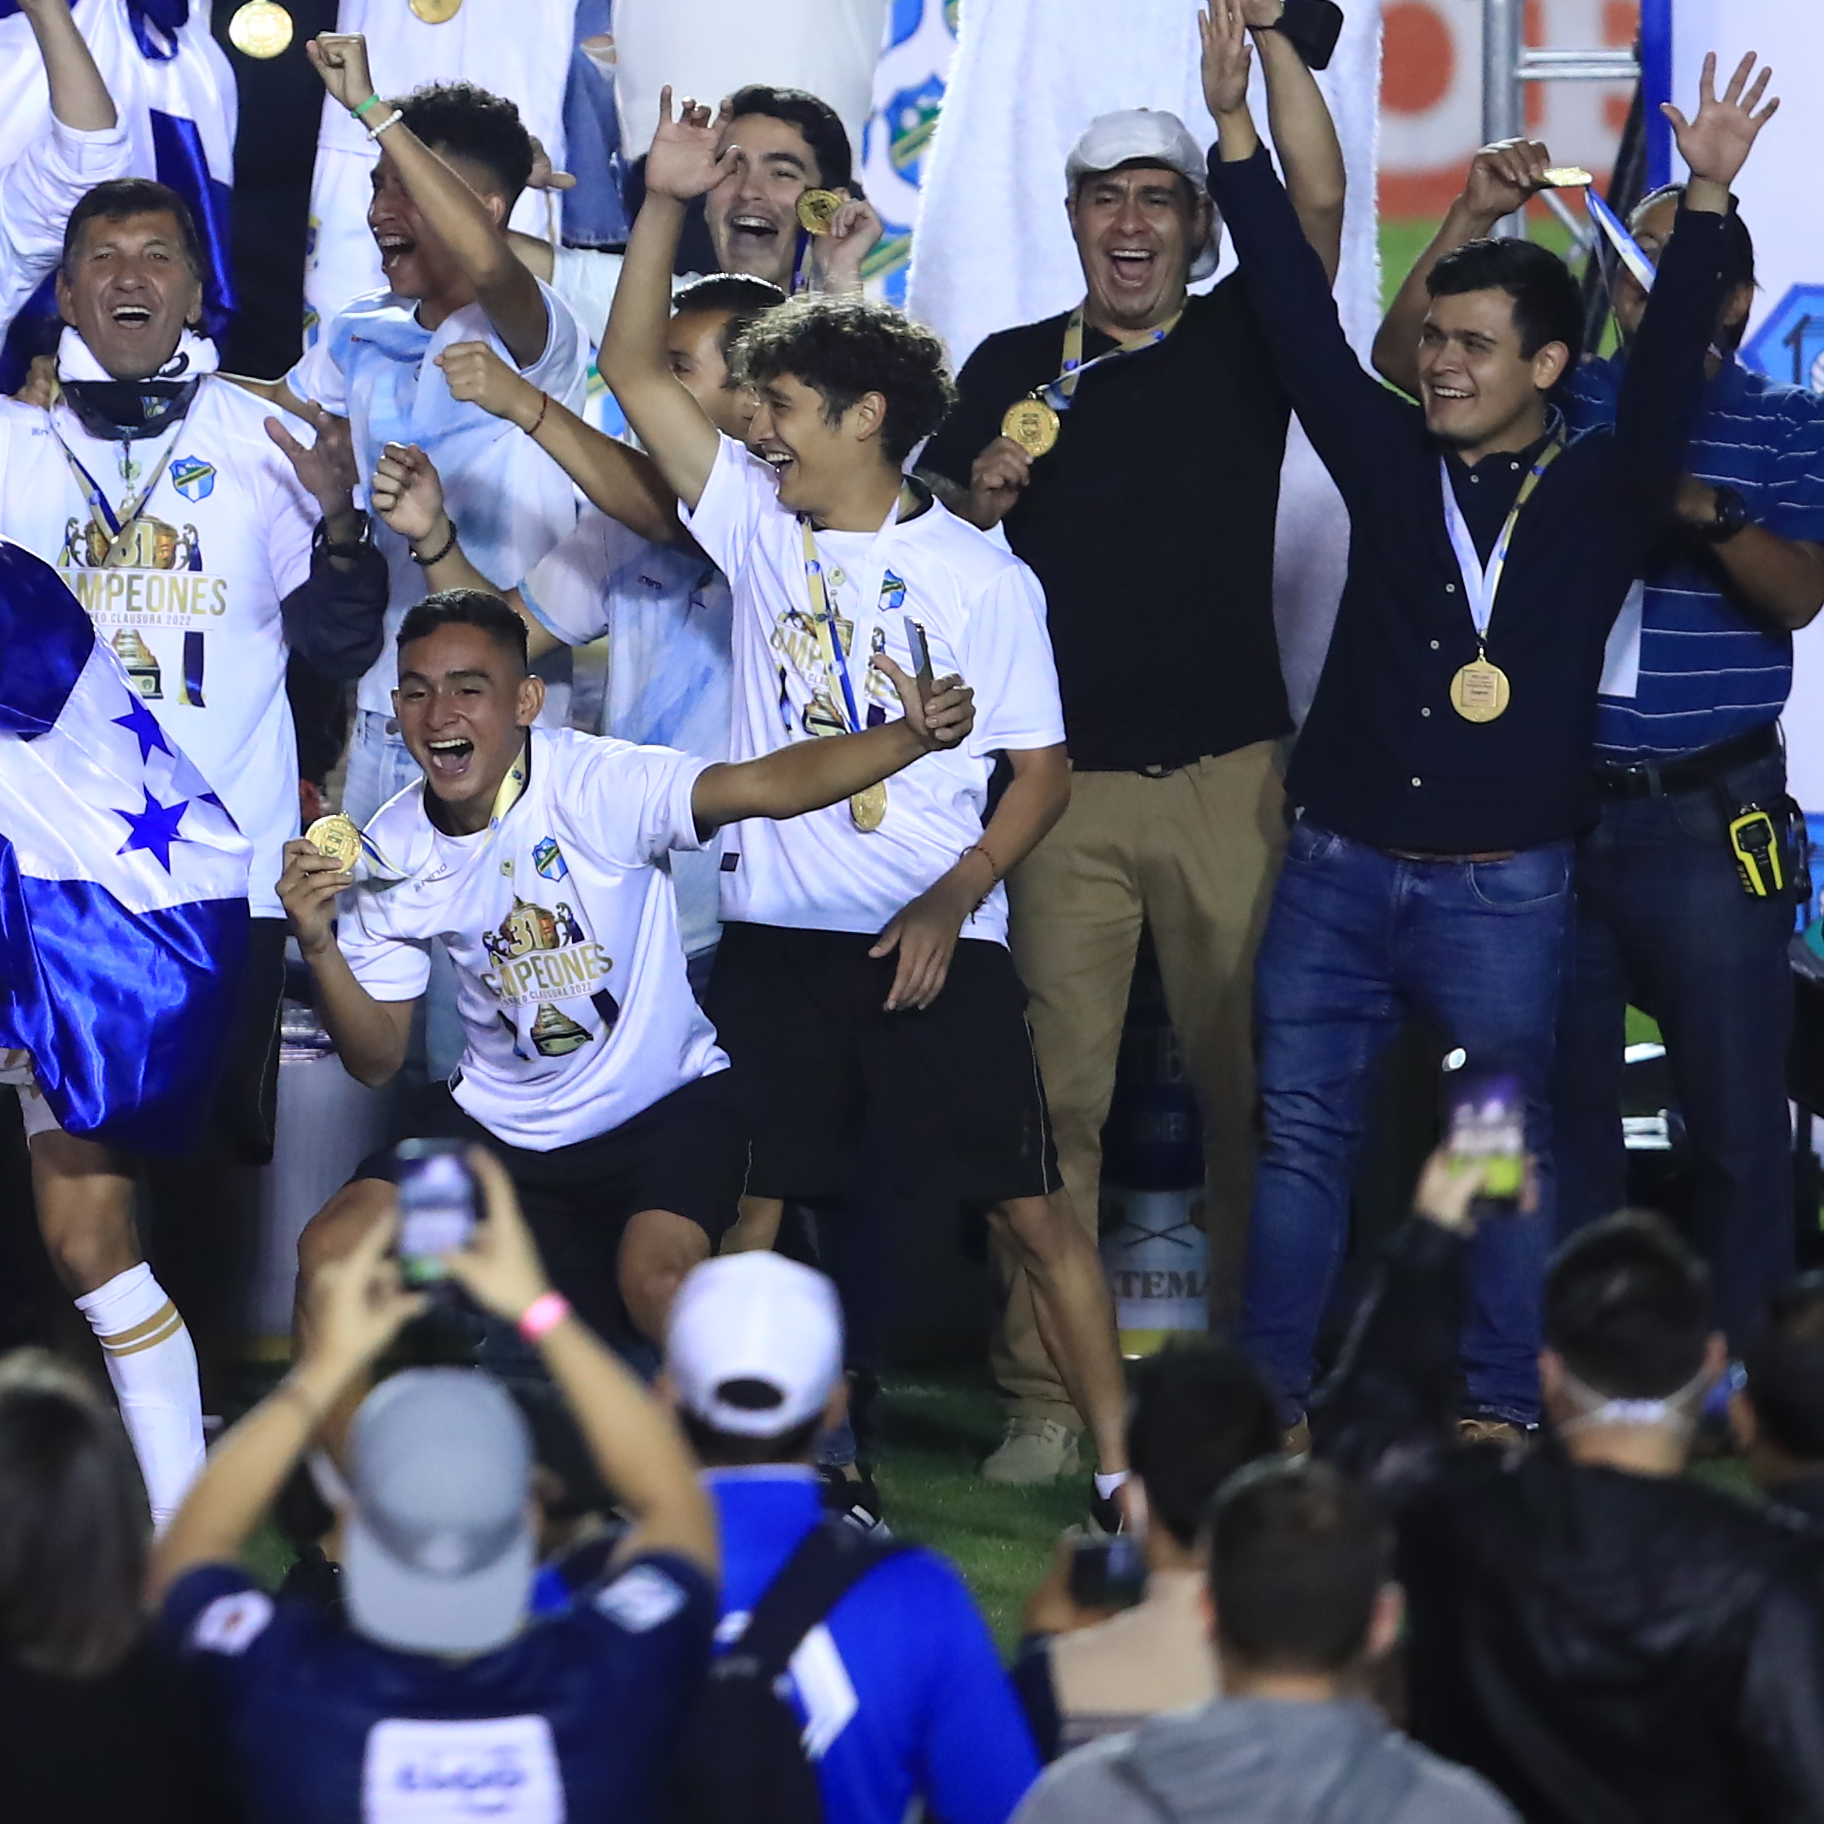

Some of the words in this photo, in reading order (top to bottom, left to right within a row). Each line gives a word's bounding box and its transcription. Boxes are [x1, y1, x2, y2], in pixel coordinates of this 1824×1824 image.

[112, 613, 163, 626] CLAUSURA
[167, 614, 192, 627] 2022
[510, 914, 543, 958] 31
[529, 986, 569, 1005] CLAUSURA
[570, 981, 593, 997] 2022
